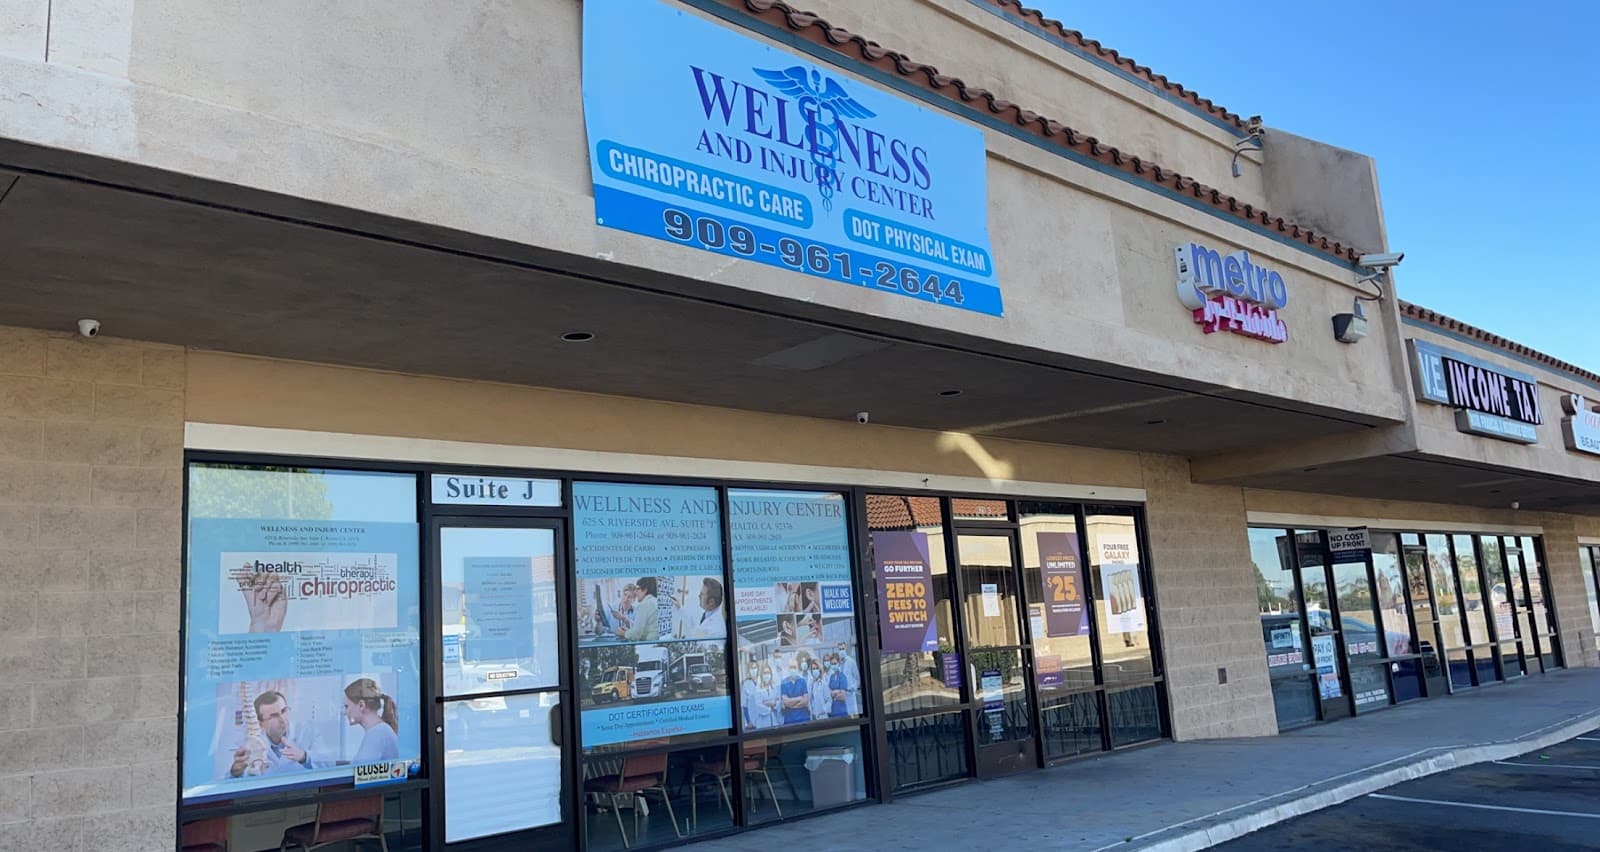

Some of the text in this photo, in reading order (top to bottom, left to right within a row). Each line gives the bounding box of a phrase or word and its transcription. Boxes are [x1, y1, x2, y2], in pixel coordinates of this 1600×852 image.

[689, 64, 931, 191] WELLNESS
[696, 129, 935, 221] AND INJURY CENTER
[608, 148, 804, 222] CHIROPRACTIC CARE
[852, 215, 986, 272] DOT PHYSICAL EXAM
[663, 208, 964, 304] 909-961-2644
[1190, 242, 1287, 309] metro
[1448, 359, 1512, 417] INCOME
[1512, 378, 1544, 425] TAX
[447, 477, 534, 500] Suite J
[573, 495, 718, 514] WELLNESS AND
[785, 502, 842, 518] CENTER
[260, 524, 298, 534] WELLNESS
[607, 517, 657, 527] RIVERSIDE
[680, 519, 704, 529] SUITE
[1330, 532, 1364, 543] NO COST
[1331, 539, 1365, 550] UP FRONT
[1103, 543, 1117, 551] FOUR
[1104, 551, 1130, 560] GALAXY
[254, 560, 302, 573] health
[884, 564, 924, 573] GO FURTHER
[1046, 560, 1076, 569] UNLIMITED
[340, 567, 374, 580] therapy
[301, 577, 396, 600] chiropractic
[824, 588, 849, 598] WALK INS
[886, 582, 926, 599] ZERO
[1047, 575, 1077, 602] $25
[825, 598, 850, 609] WELCOME
[888, 597, 927, 611] FEES TO
[889, 610, 928, 624] SWITCH
[608, 712, 624, 722] DOT
[626, 706, 680, 719] CERTIFICATION
[356, 761, 390, 777] CLOSED
